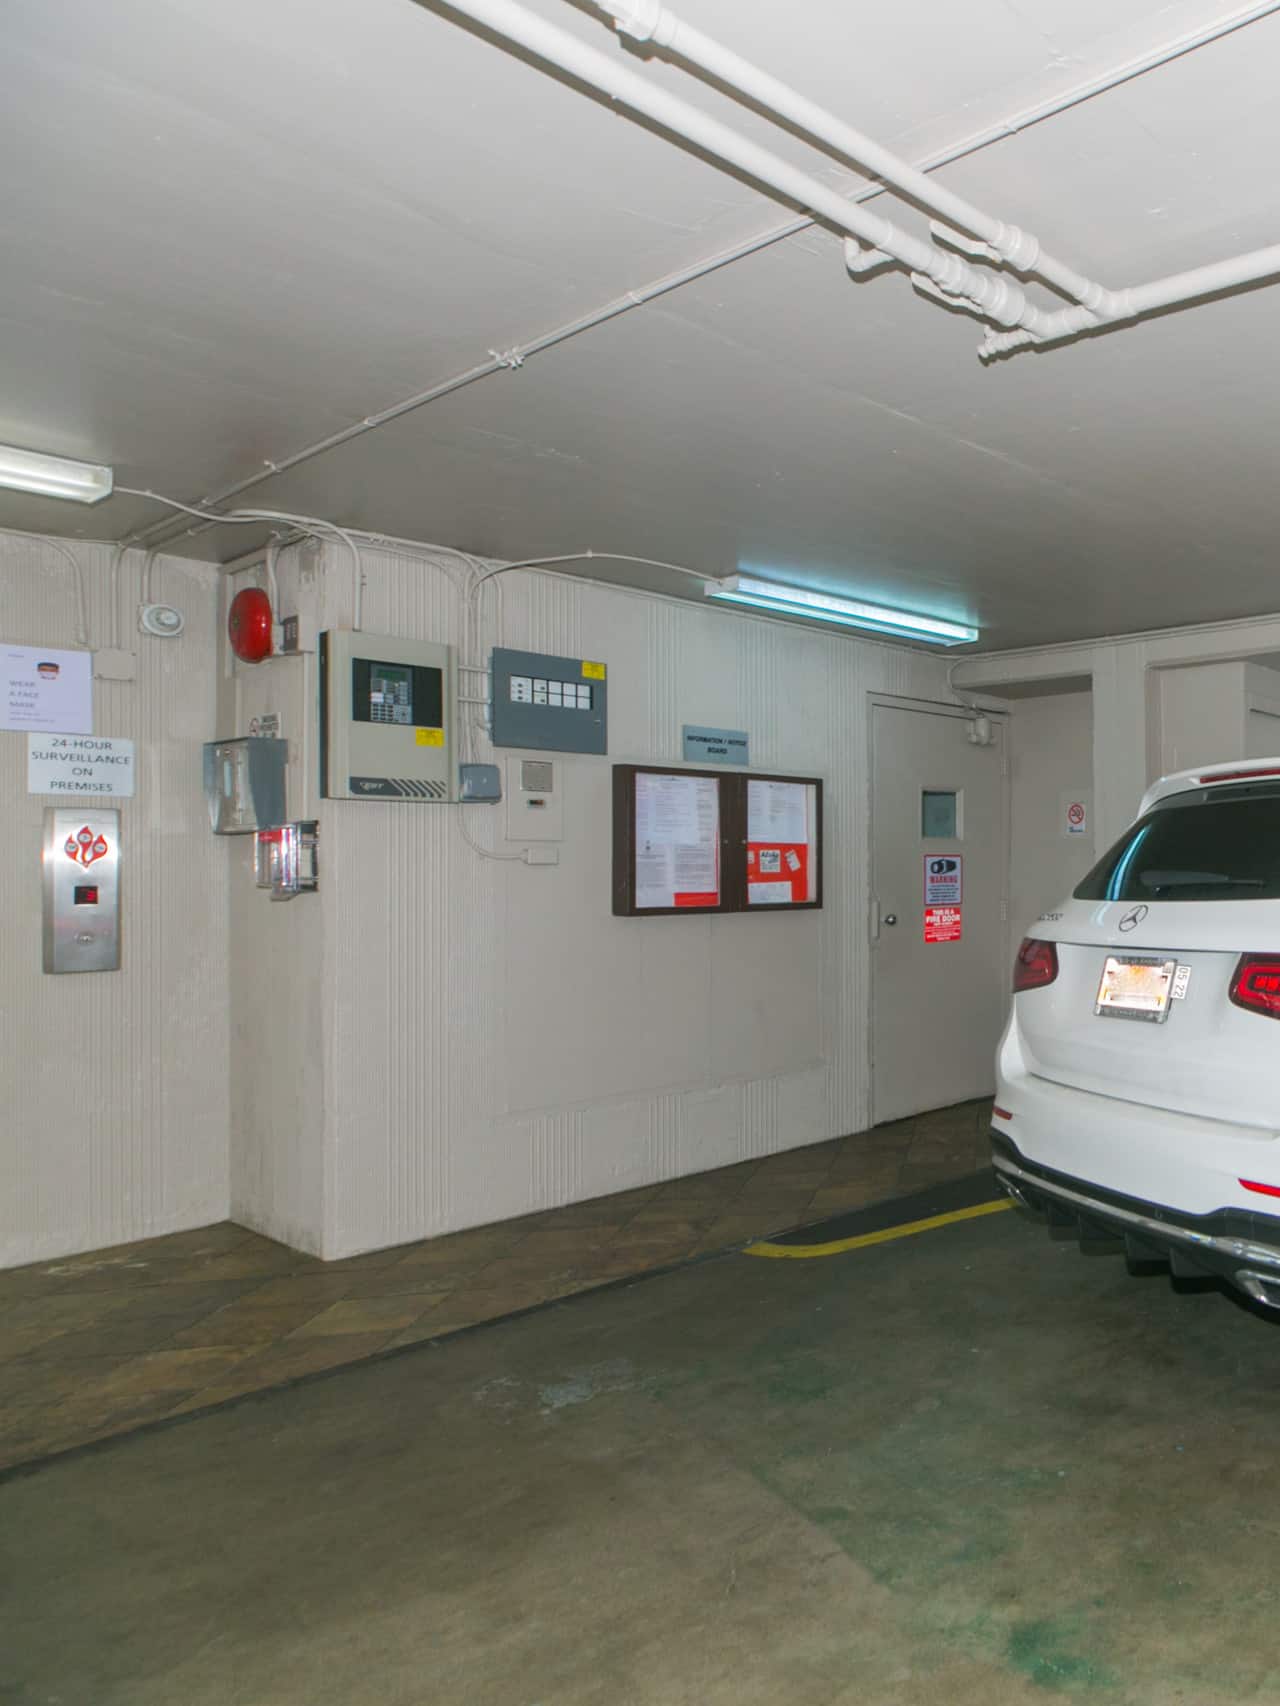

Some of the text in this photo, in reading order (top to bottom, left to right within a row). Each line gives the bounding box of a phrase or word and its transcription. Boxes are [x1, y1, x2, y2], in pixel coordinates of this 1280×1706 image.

[51, 738, 113, 750] 24-HOUR
[31, 751, 131, 765] SURVEILLANCE
[71, 767, 94, 777] ON
[50, 780, 113, 792] PREMISES
